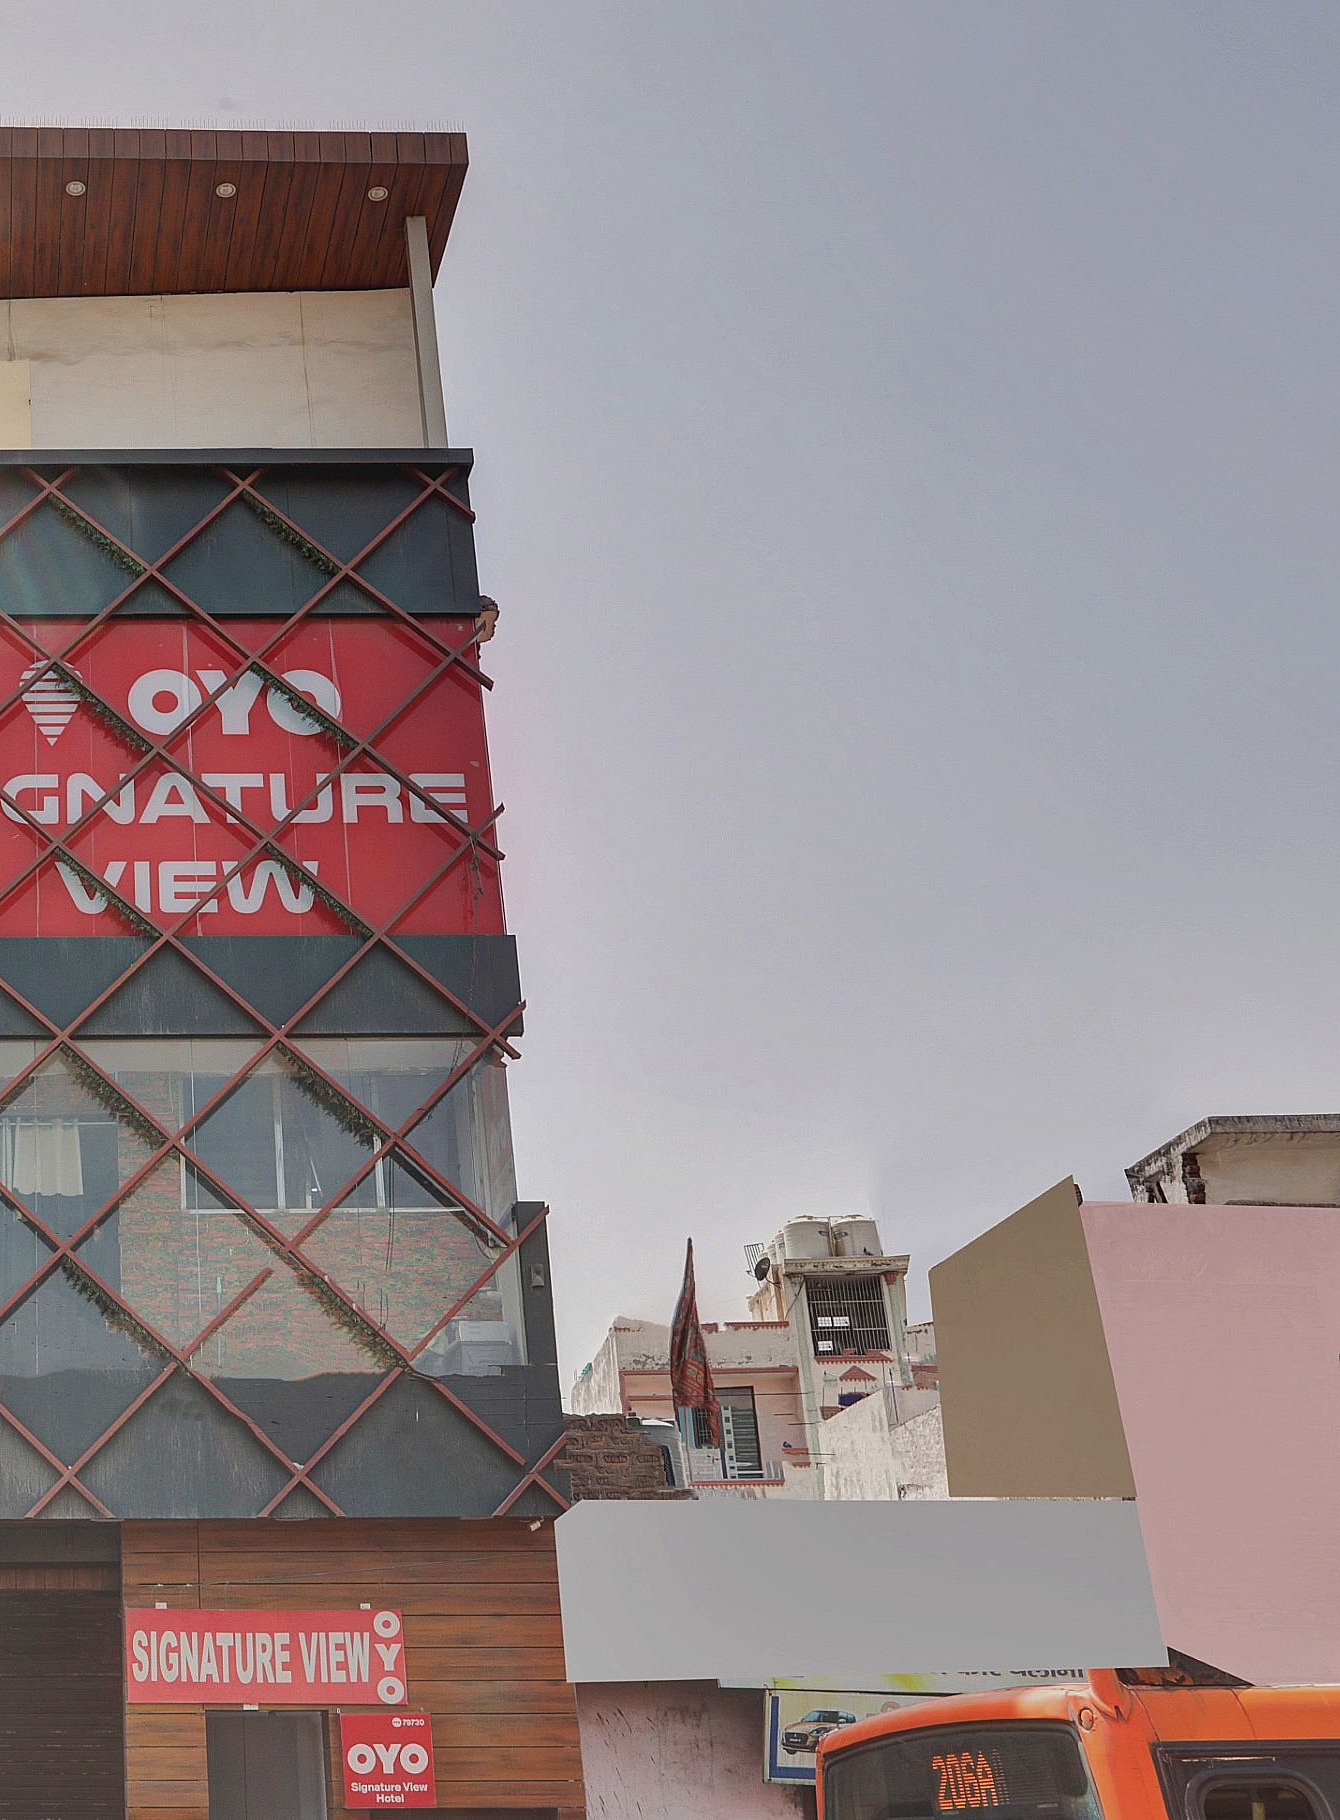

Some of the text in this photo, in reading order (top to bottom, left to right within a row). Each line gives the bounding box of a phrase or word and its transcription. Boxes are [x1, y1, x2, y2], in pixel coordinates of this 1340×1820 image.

[128, 669, 342, 736] OYO
[55, 861, 319, 914] VIEW
[132, 1630, 370, 1684] SIGNATURE VIEW
[373, 1610, 405, 1705] OYO
[347, 1743, 429, 1774] OYO
[932, 1751, 999, 1810] 206A
[351, 1782, 428, 1793] Signature View
[376, 1794, 404, 1803] Hotel
